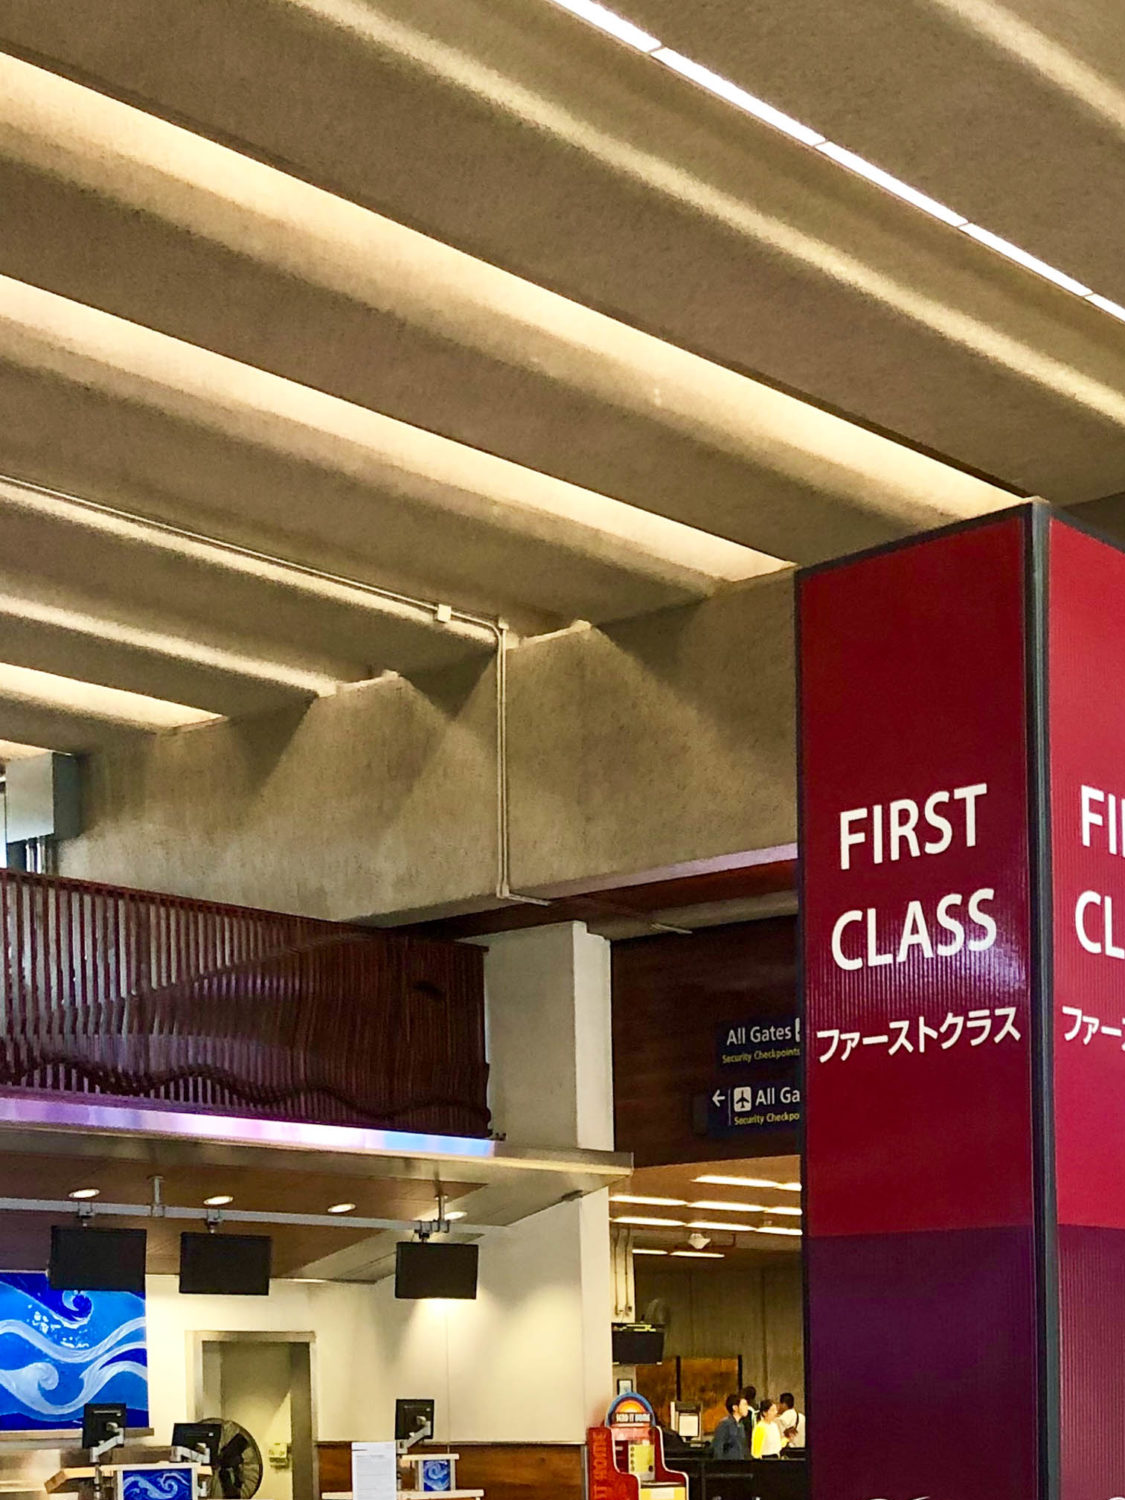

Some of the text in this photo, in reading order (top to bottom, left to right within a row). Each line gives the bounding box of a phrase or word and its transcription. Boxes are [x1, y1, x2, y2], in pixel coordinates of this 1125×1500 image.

[839, 783, 988, 871] FIRST
[831, 887, 998, 971] CLASS
[727, 1024, 792, 1046] All Gates
[816, 1006, 1021, 1064] ファーストクラス
[722, 1053, 752, 1065] Security
[756, 1088, 775, 1106] All
[734, 1115, 764, 1126] Security
